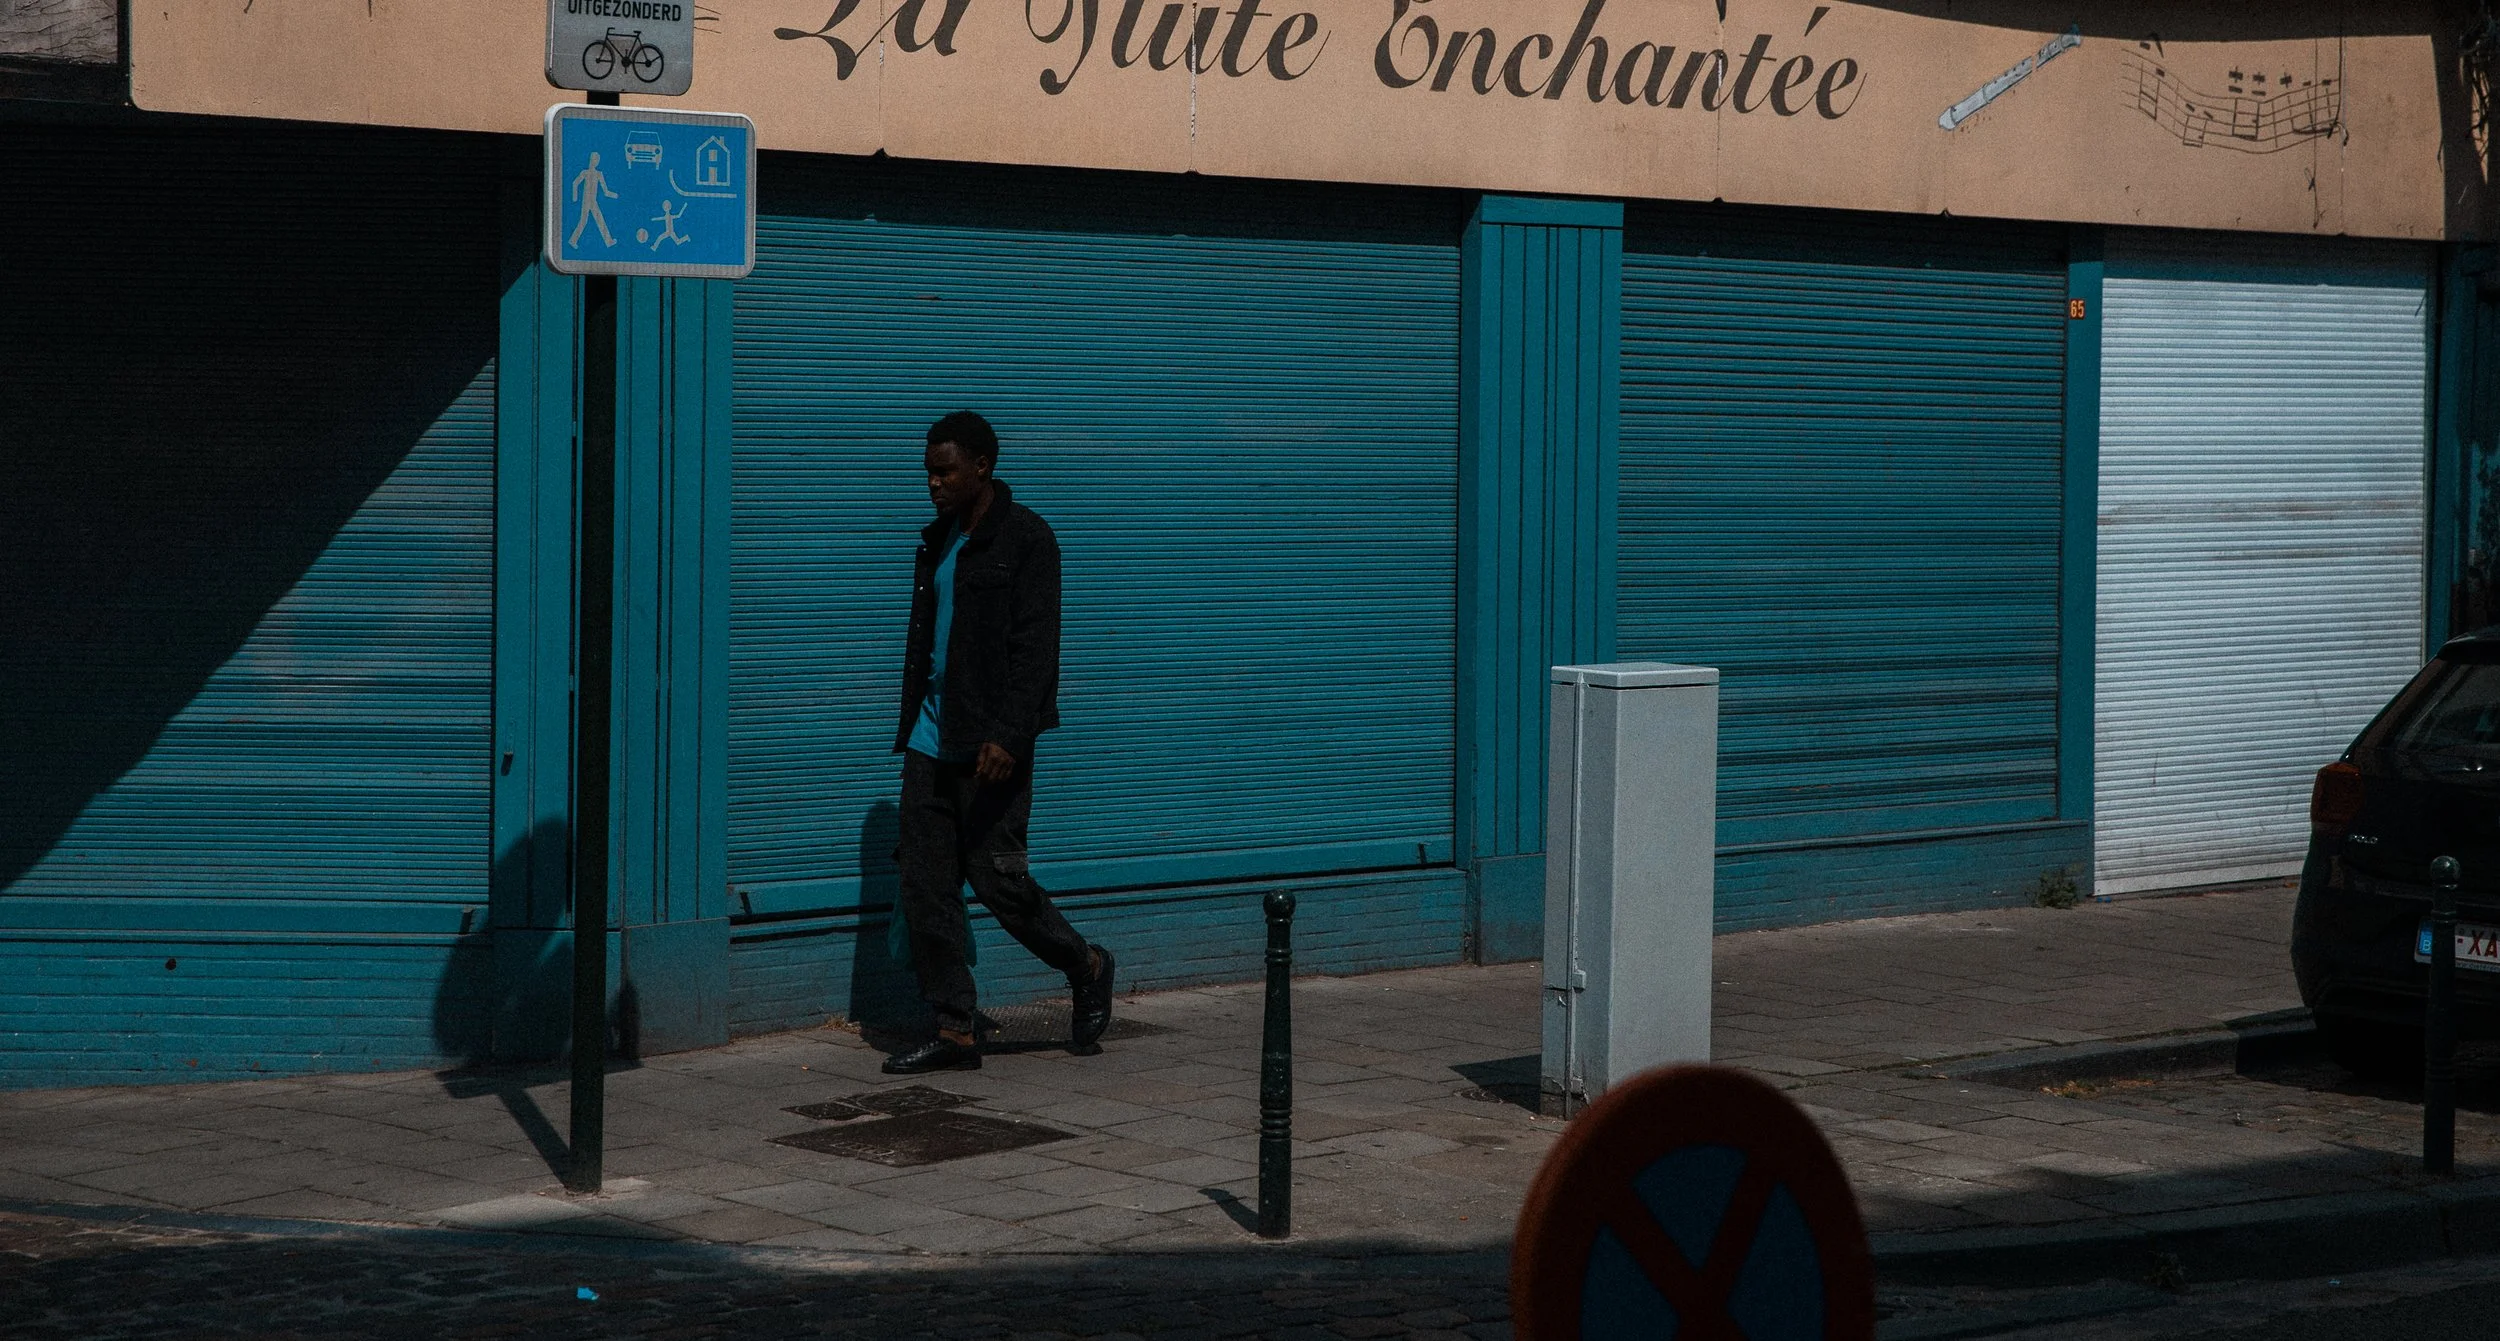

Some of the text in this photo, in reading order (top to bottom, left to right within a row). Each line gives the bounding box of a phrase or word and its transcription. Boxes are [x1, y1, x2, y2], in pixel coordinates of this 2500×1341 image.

[567, 0, 682, 22] UITGEZONDERD
[773, 0, 957, 81] La
[1374, 0, 1868, 119] Enchantée
[2070, 299, 2085, 318] 65
